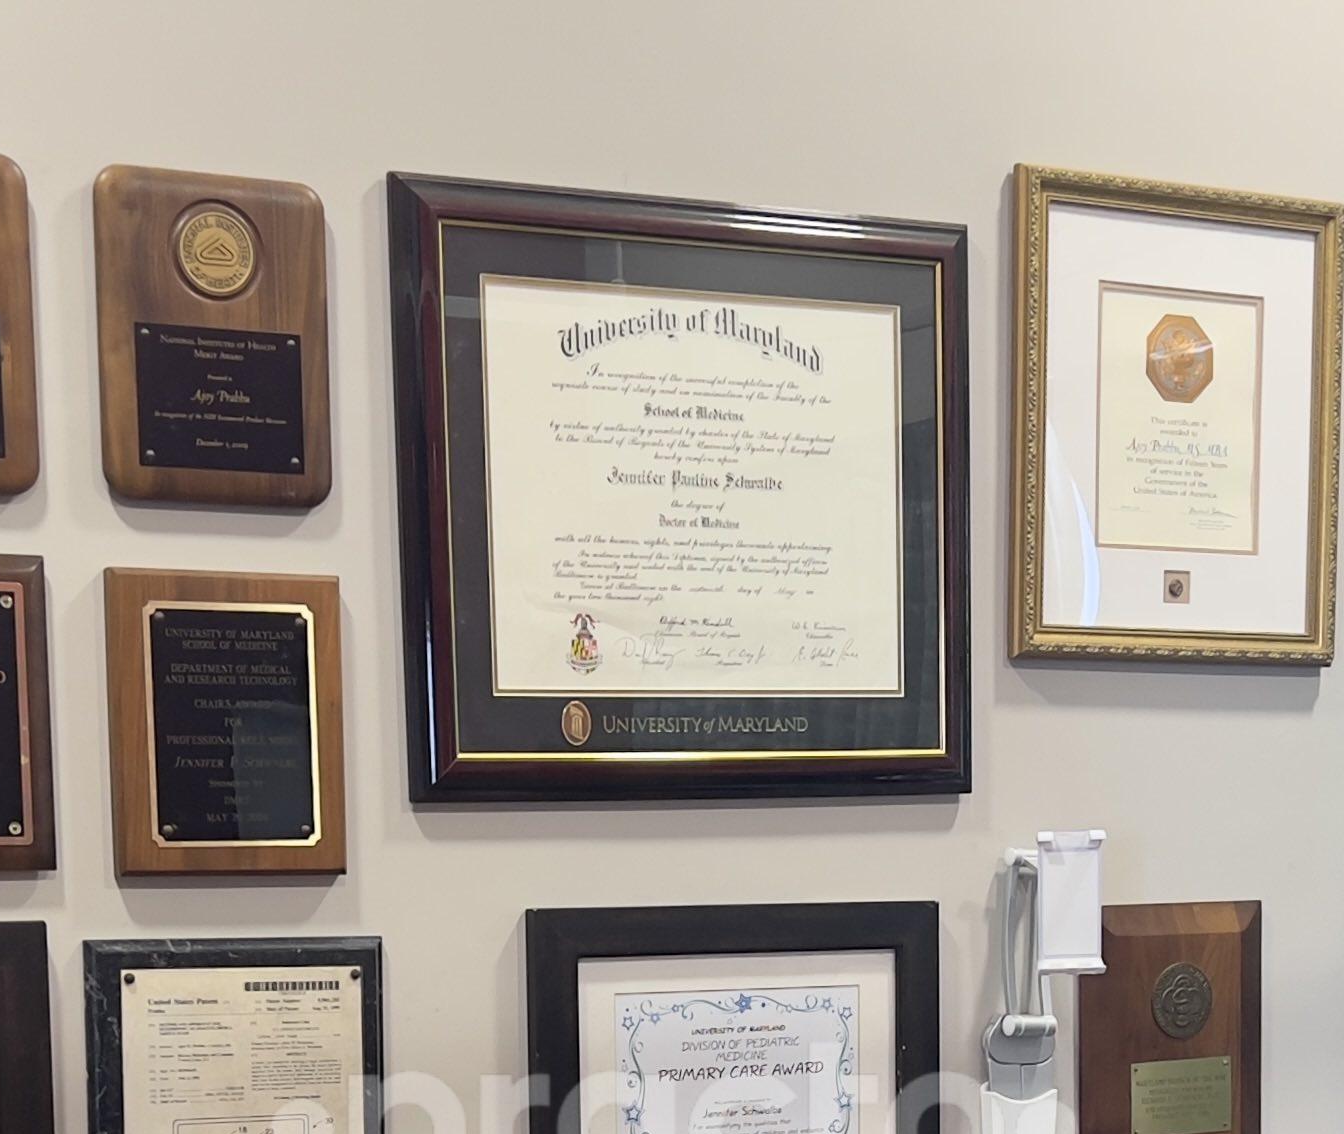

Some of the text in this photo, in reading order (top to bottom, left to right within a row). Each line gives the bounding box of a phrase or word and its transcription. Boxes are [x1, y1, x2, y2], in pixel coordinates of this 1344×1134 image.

[557, 307, 820, 373] University of Maryland
[603, 715, 809, 734] UNIVERSITY of MARYLAND
[691, 1025, 736, 1036] UNIVERSITY
[737, 1025, 748, 1034] OF
[682, 1036, 800, 1053] DIVISION OF PEDIATRIC
[716, 1051, 768, 1062] MEDICINE
[657, 1060, 824, 1083] PRIMARY CARE AWARD
[702, 1107, 739, 1119] Jennifer
